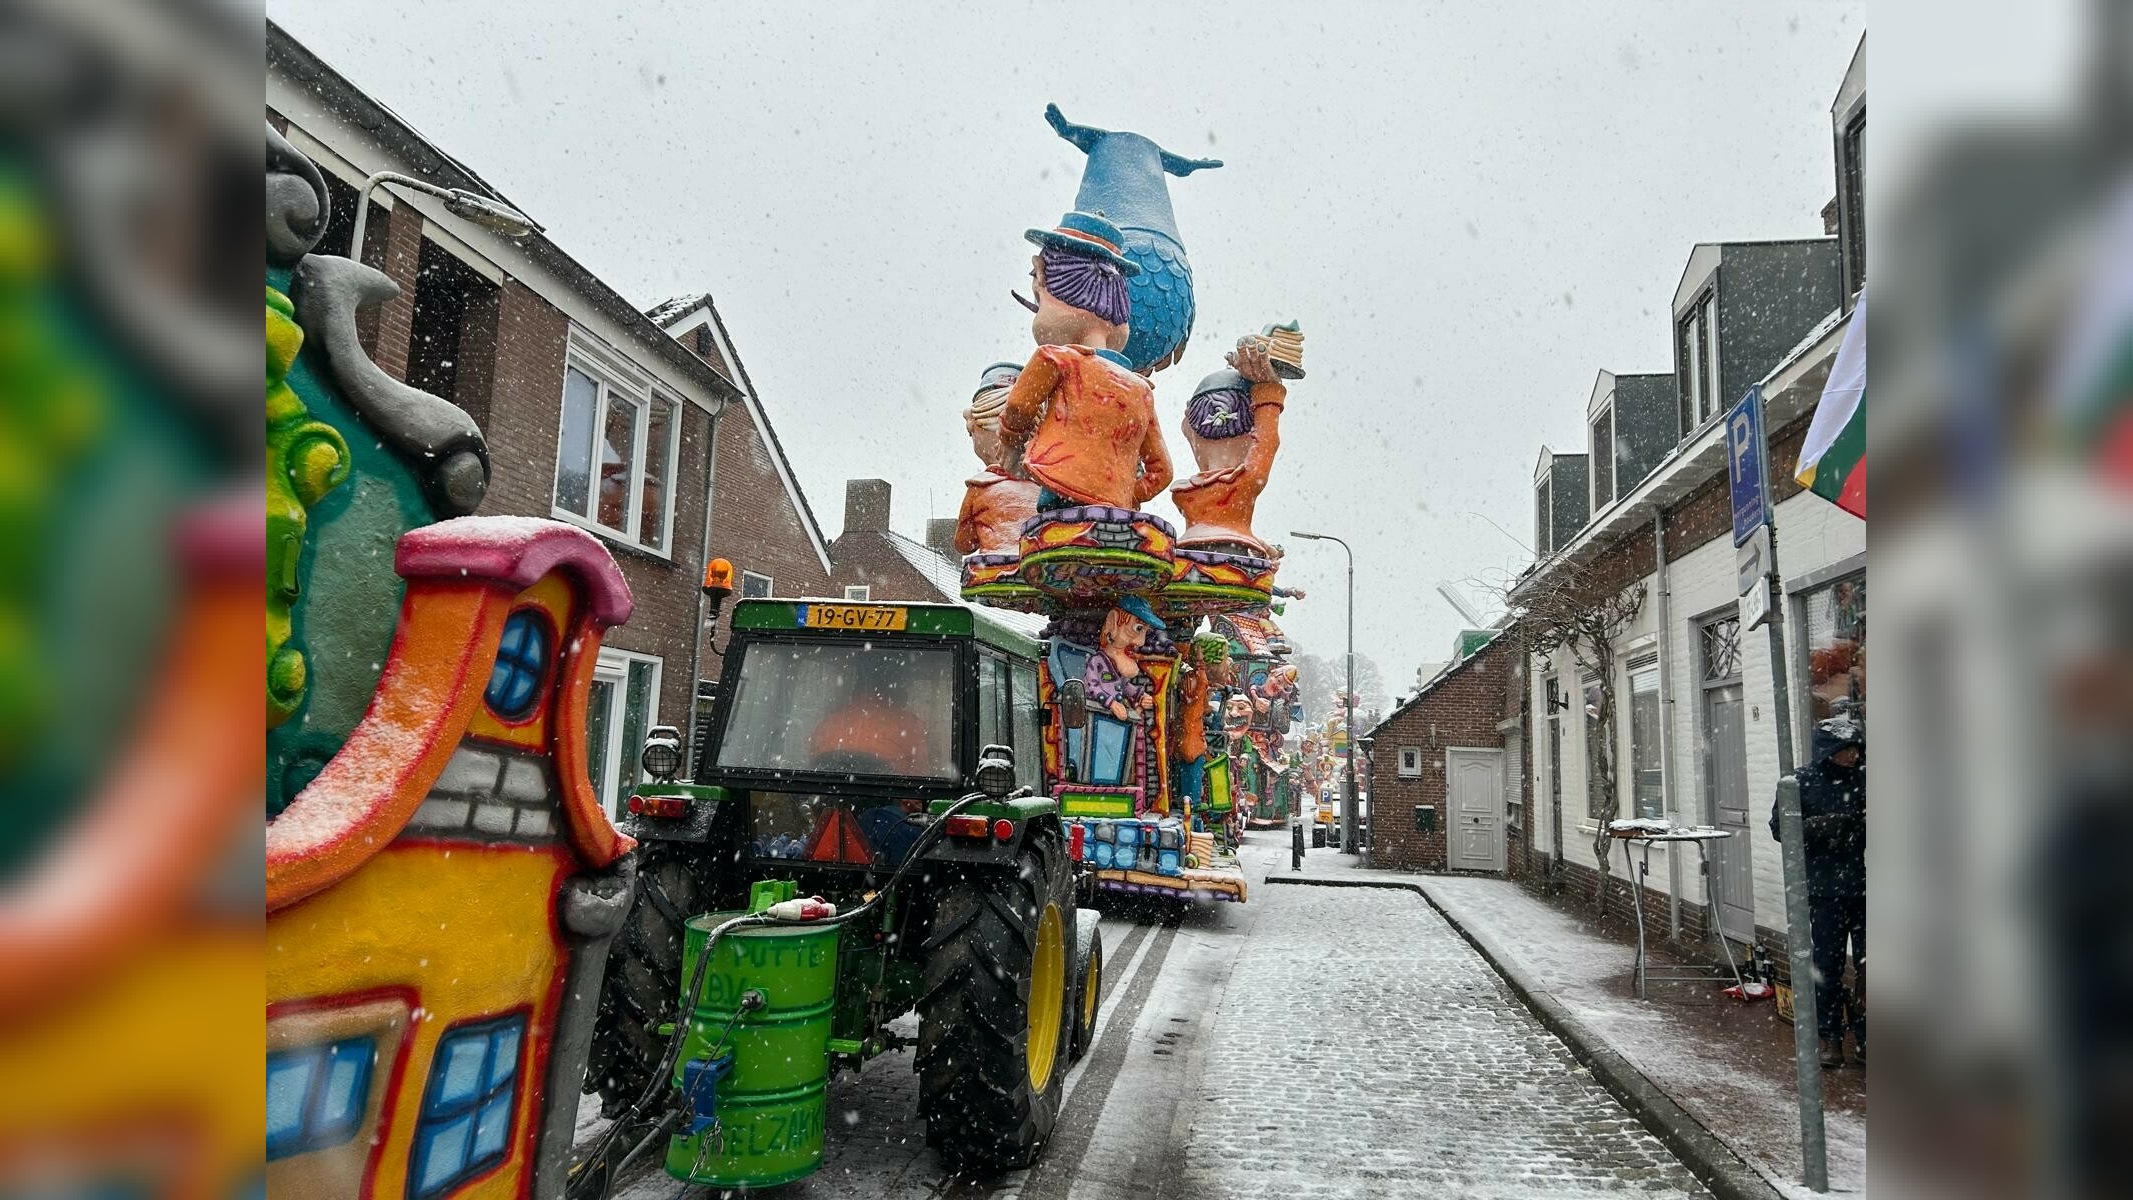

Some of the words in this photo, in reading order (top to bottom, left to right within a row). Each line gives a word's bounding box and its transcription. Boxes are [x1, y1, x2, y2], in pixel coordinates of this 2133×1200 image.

[1732, 411, 1750, 484] P
[816, 608, 897, 627] 19-GV-77
[1322, 790, 1329, 802] P
[733, 942, 820, 968] PUTTE
